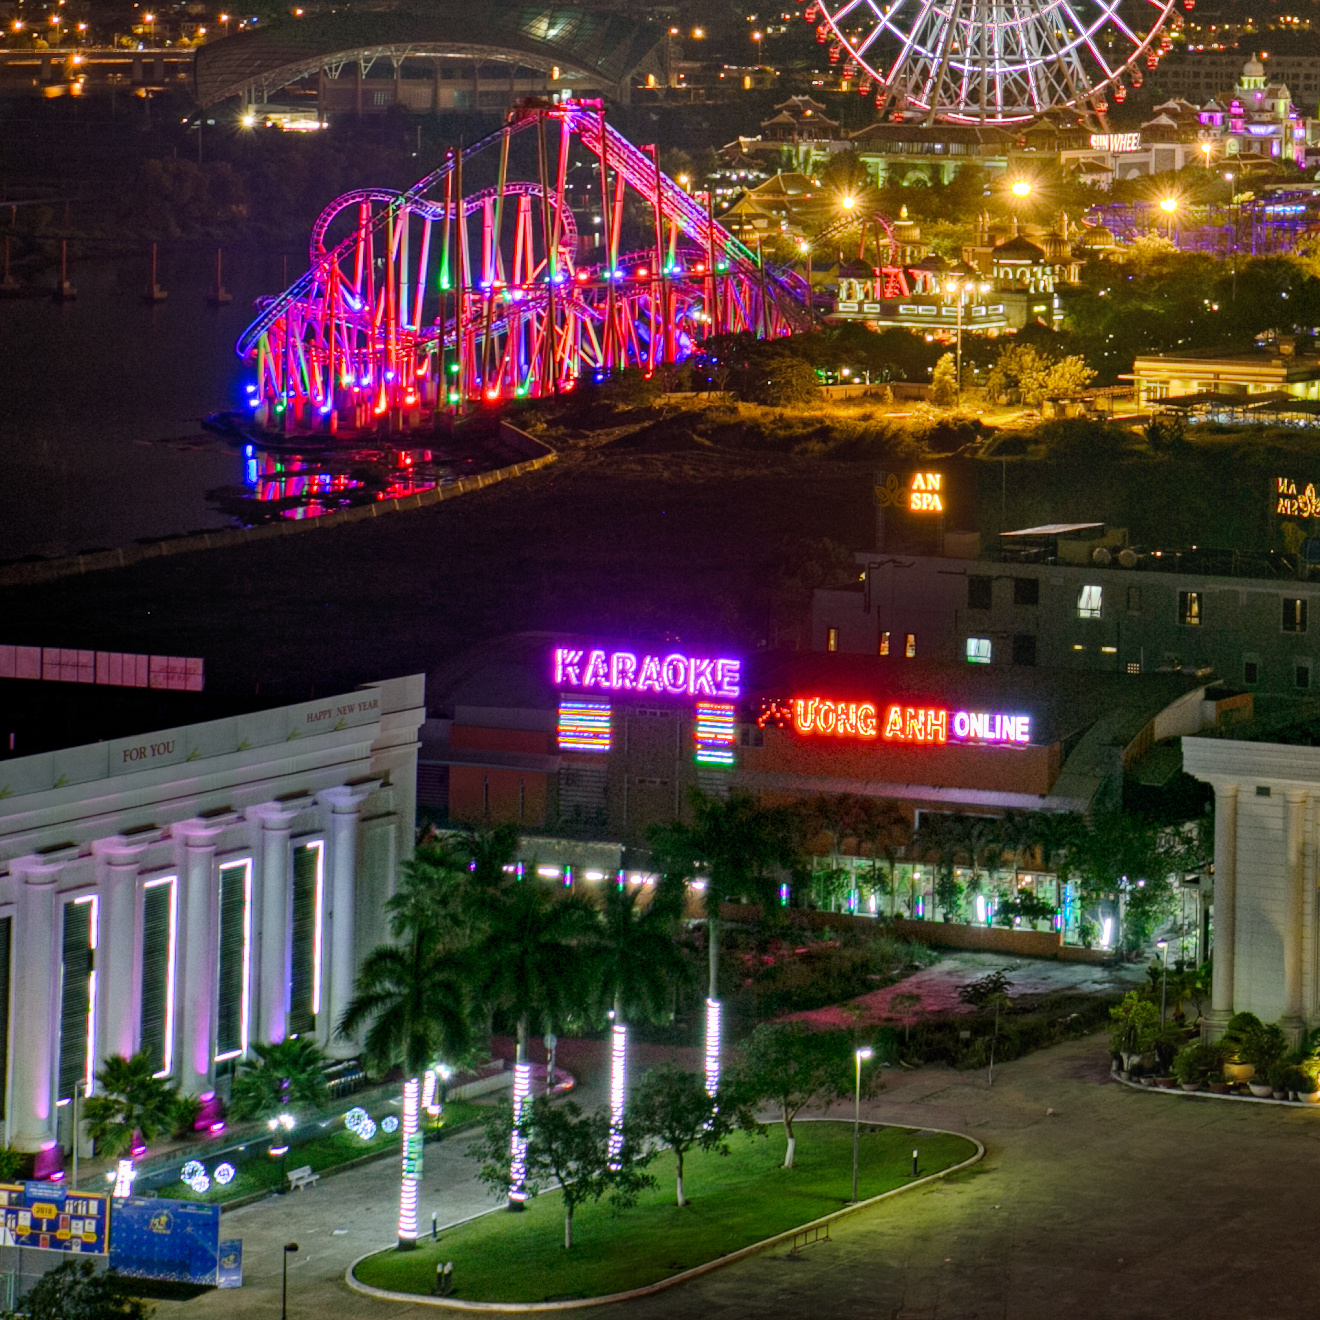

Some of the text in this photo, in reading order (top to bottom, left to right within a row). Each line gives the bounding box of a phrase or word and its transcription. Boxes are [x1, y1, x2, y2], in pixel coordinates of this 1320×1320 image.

[912, 473, 941, 490] AN
[910, 492, 942, 511] SPA
[554, 648, 741, 697] KARAOKE
[306, 699, 379, 723] HAPPY NEW YEAR
[885, 706, 946, 741] ANH
[953, 711, 1030, 742] ONLINE
[122, 740, 176, 763] FOR YOU
